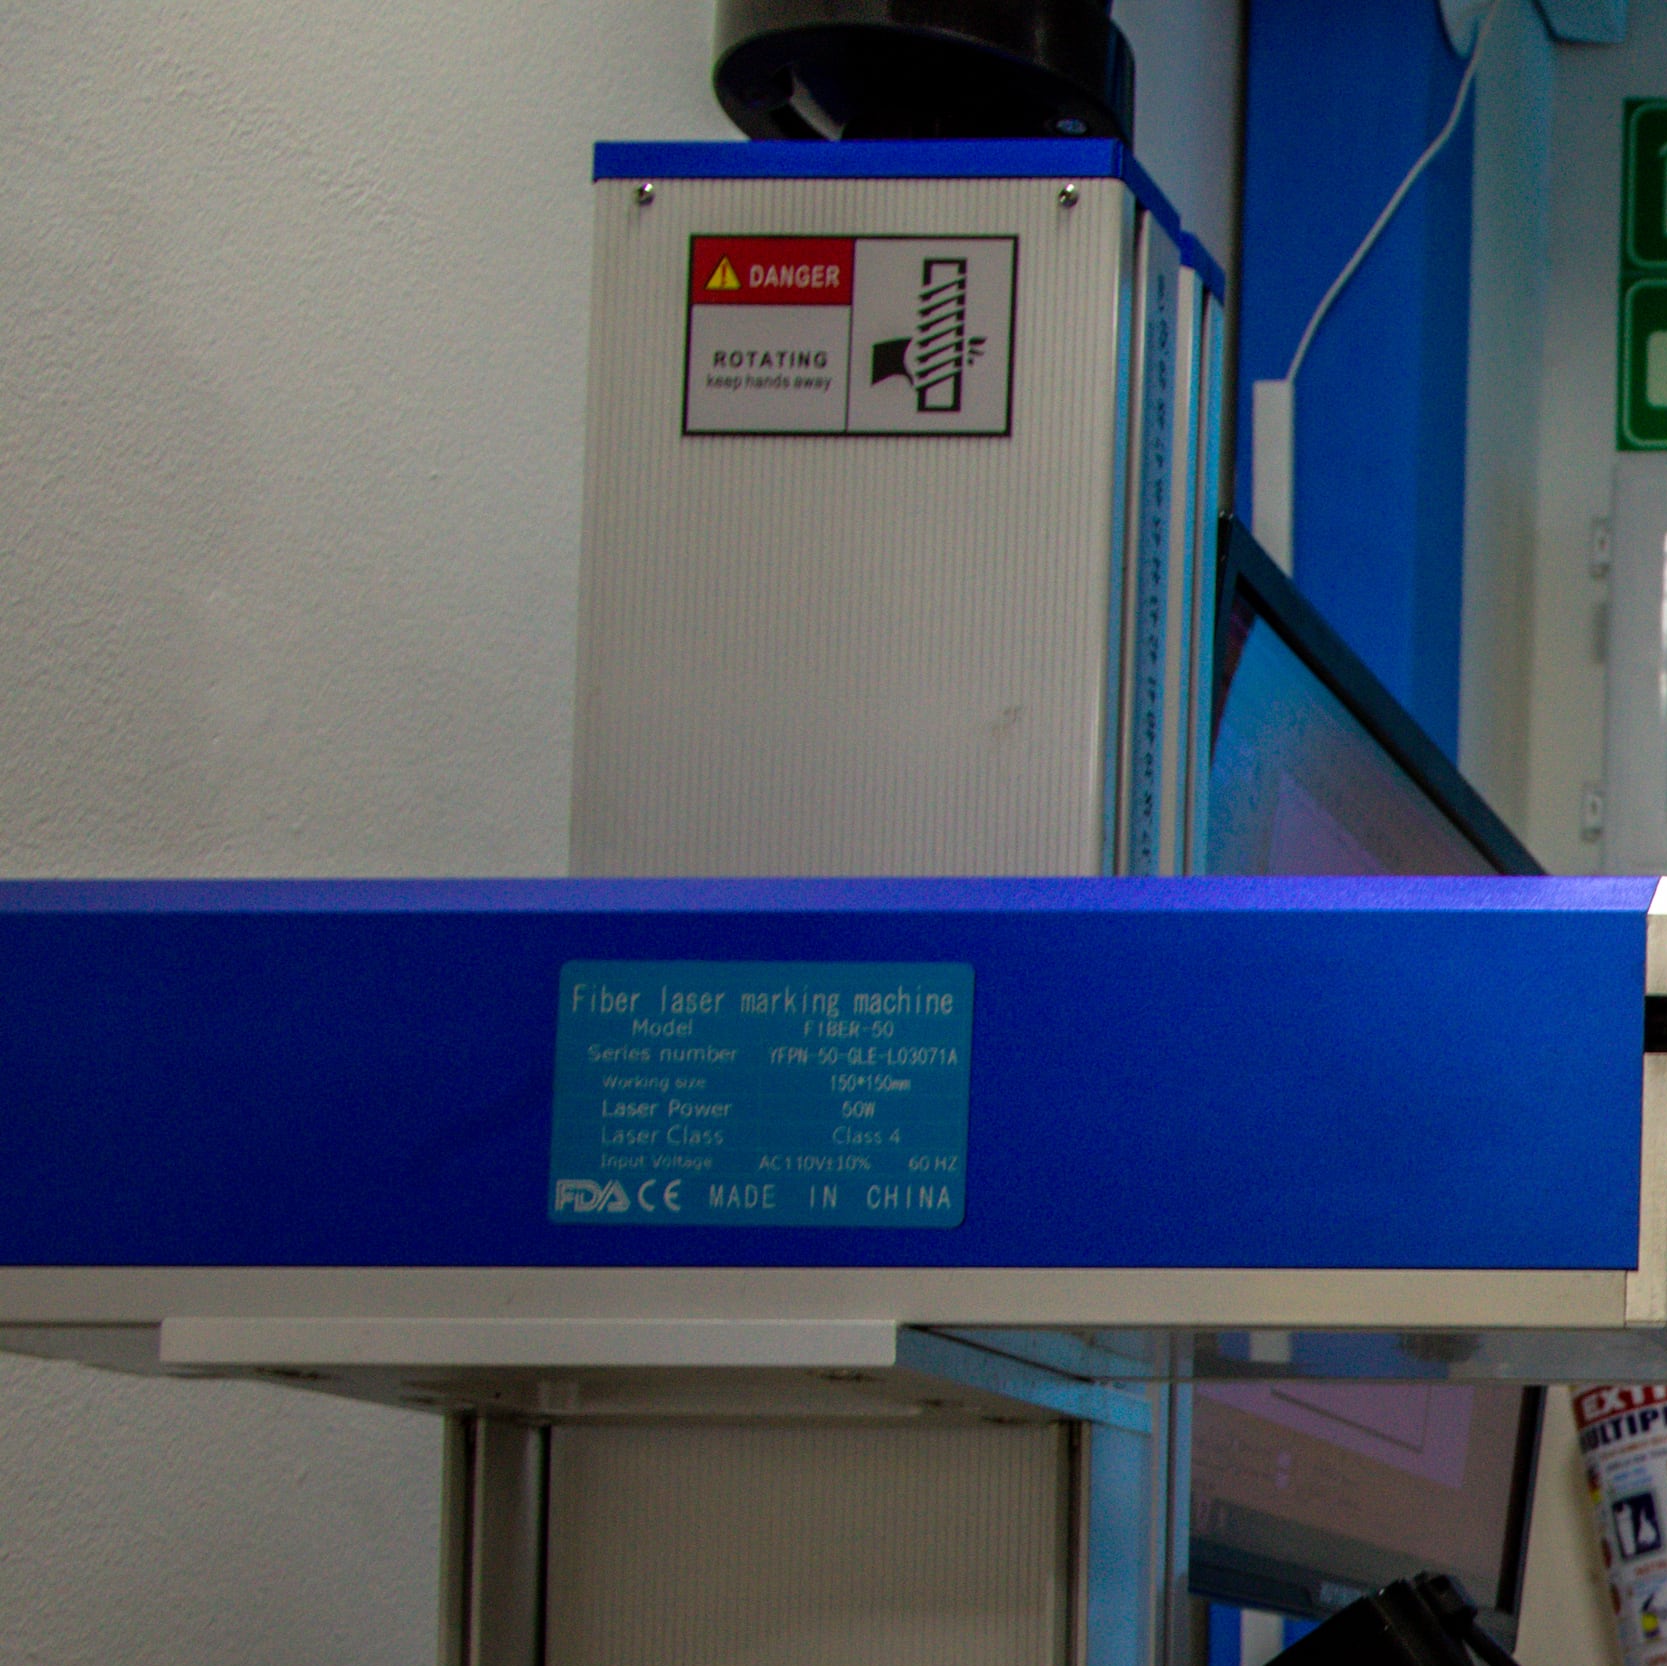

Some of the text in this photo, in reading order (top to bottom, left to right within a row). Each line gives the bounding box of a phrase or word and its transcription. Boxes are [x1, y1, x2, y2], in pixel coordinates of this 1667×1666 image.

[749, 264, 841, 289] DANGER
[713, 350, 828, 369] ROTATING
[706, 374, 832, 393] keep hands away
[571, 983, 954, 1019] Fiber laser marking machine
[631, 1018, 694, 1038] Model
[587, 1044, 651, 1063] Series
[658, 1044, 738, 1064] number
[602, 1073, 670, 1093] Working
[601, 1099, 658, 1119] Laser
[668, 1099, 733, 1119] Power
[601, 1124, 901, 1145] Laser Class Class 4
[555, 1179, 952, 1212] FDA CE MADE IN CHINA
